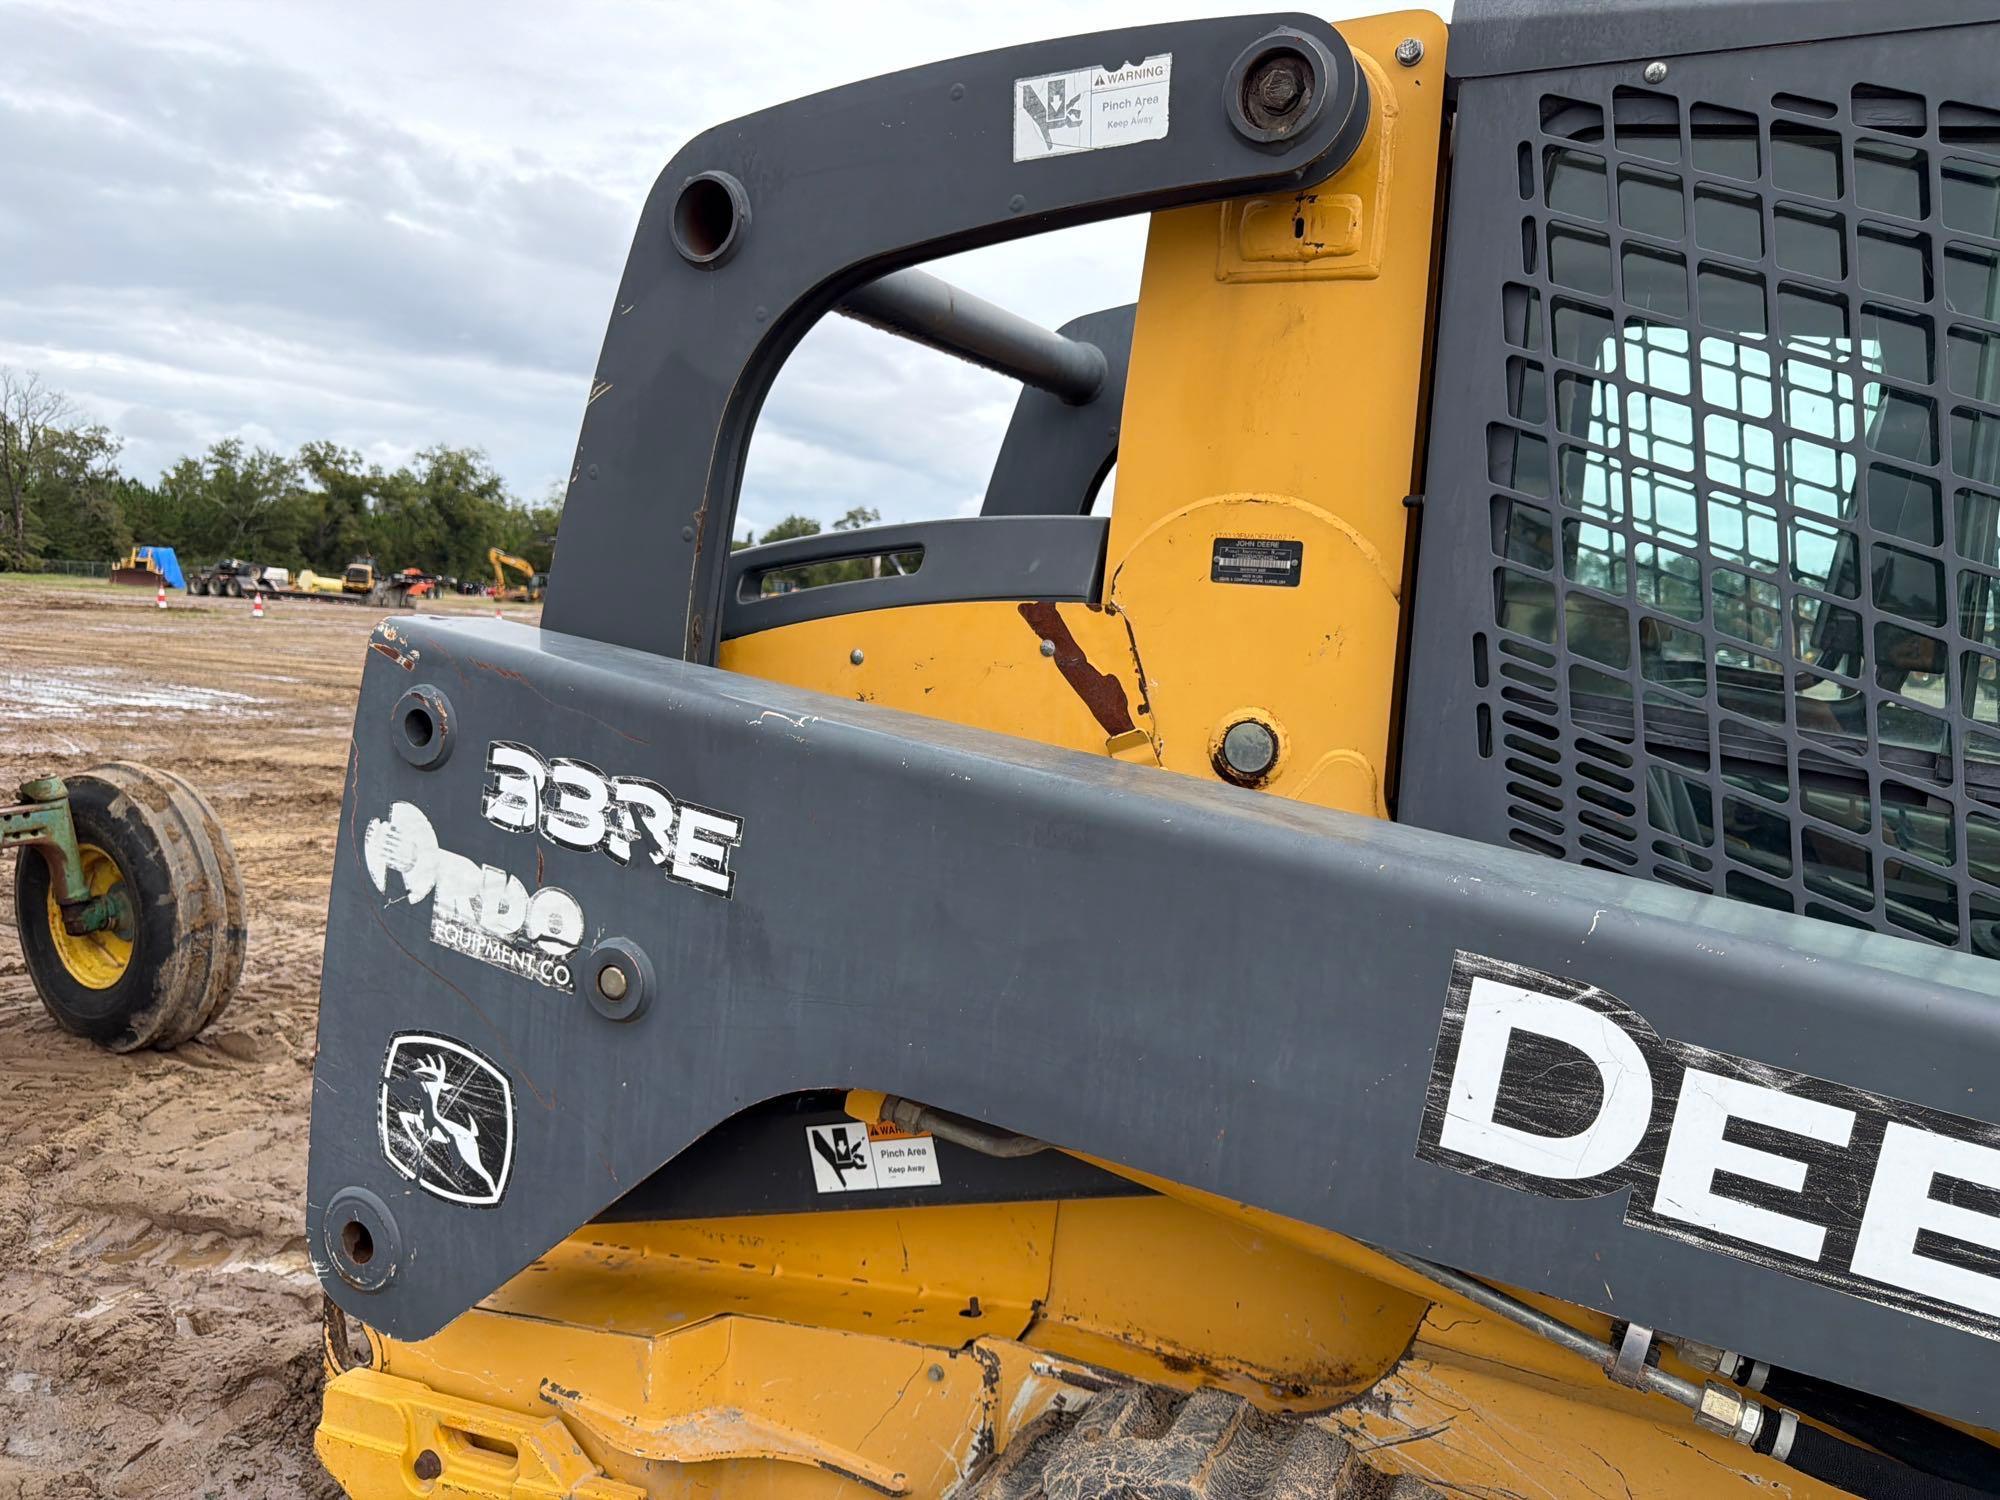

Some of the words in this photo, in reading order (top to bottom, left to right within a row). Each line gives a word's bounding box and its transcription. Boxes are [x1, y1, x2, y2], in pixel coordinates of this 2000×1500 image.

[1107, 65, 1164, 85] WARNING
[1102, 100, 1132, 113] Pinch
[1135, 94, 1159, 107] Area
[1107, 118, 1129, 130] Keep
[1131, 115, 1153, 126] Away
[434, 922, 537, 973] EQUIPMENT
[540, 959, 574, 989] CO.
[880, 1148, 905, 1158] Pinch
[907, 1147, 927, 1156] Area
[888, 1166, 905, 1174] Keep
[907, 1165, 925, 1173] Away
